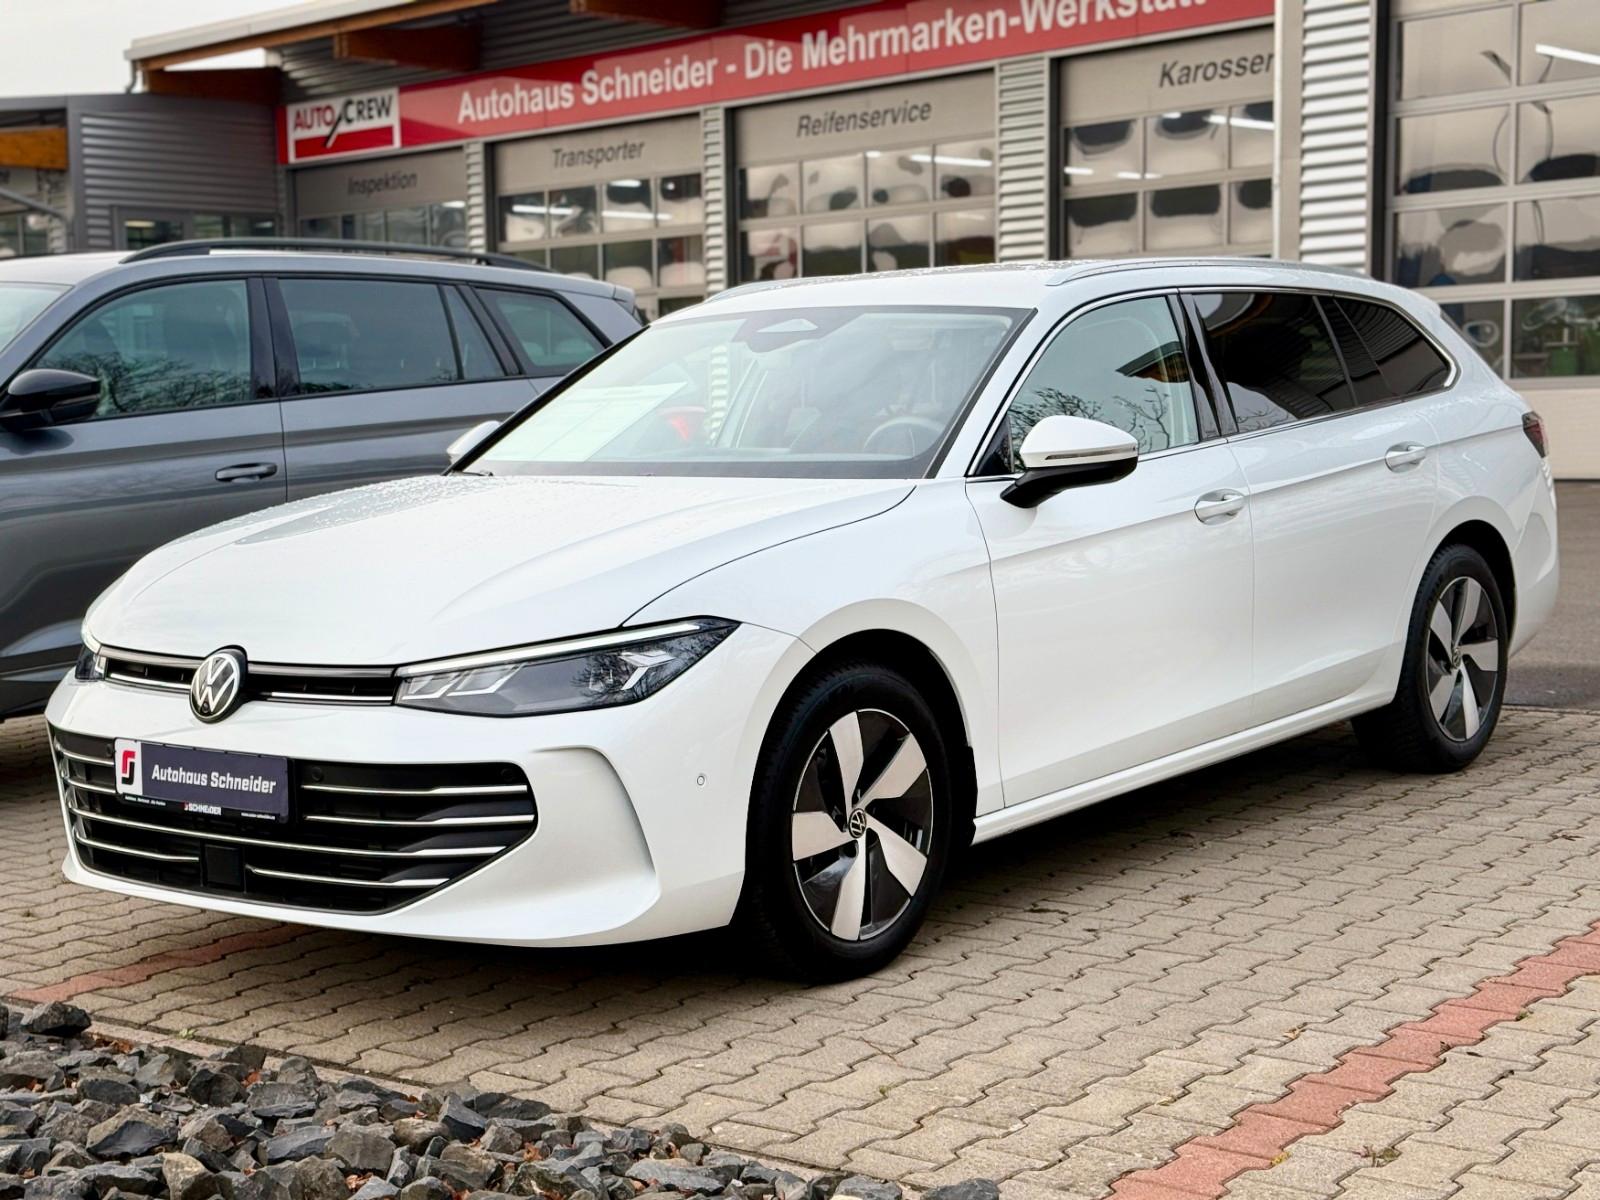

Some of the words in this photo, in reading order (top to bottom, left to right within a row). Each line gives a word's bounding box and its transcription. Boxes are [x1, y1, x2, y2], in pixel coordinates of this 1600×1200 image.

[457, 82, 574, 124] Autohaus
[581, 54, 718, 105] Schneider
[744, 39, 793, 80] Die
[1158, 53, 1274, 88] Karosser
[796, 100, 932, 138] Reifenservice
[552, 141, 645, 169] Transporter
[347, 171, 417, 198] Inspektion
[151, 764, 208, 786] Autohaus
[210, 771, 276, 794] Schneider
